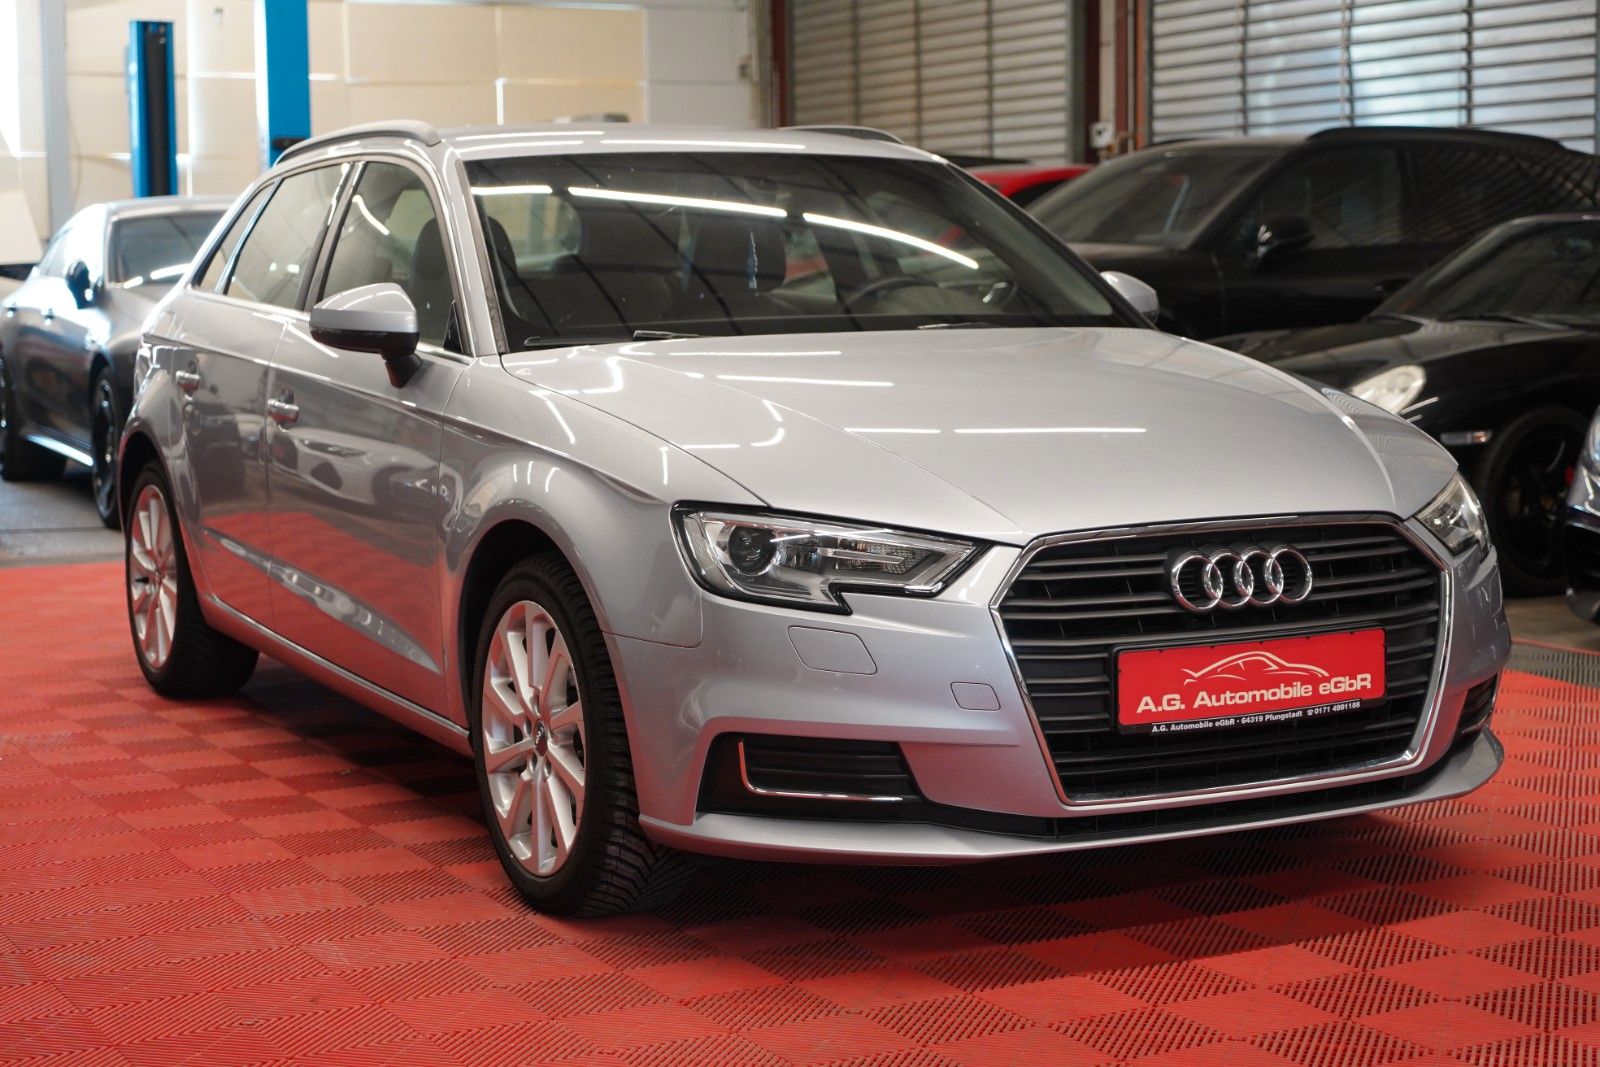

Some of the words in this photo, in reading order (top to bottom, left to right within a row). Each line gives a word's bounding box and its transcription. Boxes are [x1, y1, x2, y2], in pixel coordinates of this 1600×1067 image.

[1136, 694, 1185, 713] A.G.
[1193, 681, 1313, 706] Automobile
[1318, 673, 1372, 695] eGbR
[1152, 725, 1168, 733] A.G.
[1170, 722, 1213, 731] Automobile
[1215, 719, 1235, 727] eGbR
[1241, 715, 1264, 724] 64319
[1265, 711, 1303, 722] Pfungstadt
[1314, 707, 1331, 716] 0171
